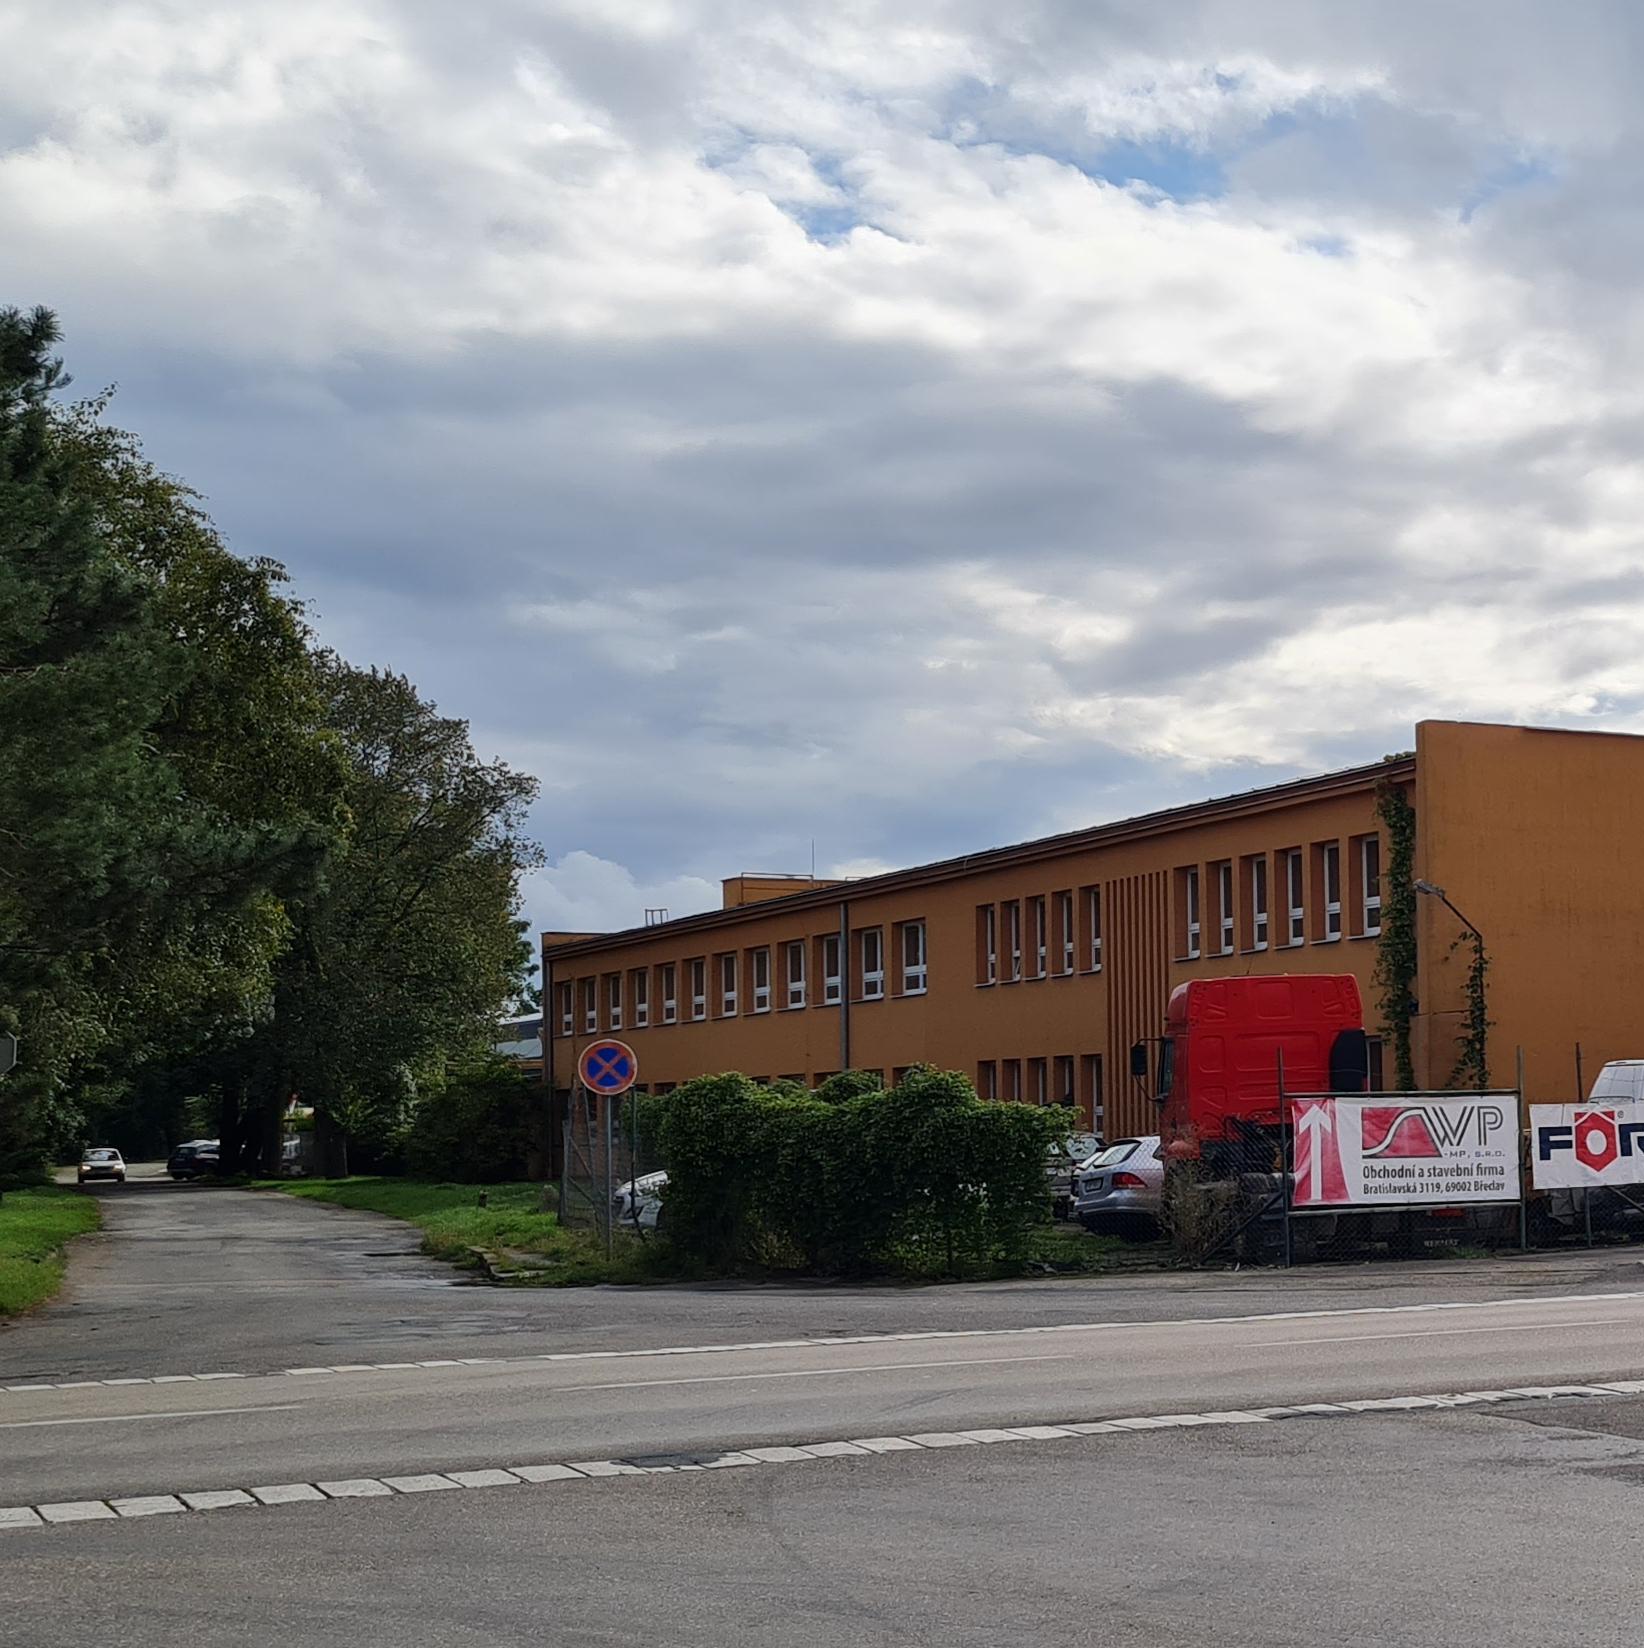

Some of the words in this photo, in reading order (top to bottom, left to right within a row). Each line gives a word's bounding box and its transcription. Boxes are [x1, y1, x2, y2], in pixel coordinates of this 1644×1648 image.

[1362, 1163, 1416, 1179] Obchodní
[1418, 1167, 1425, 1177] a
[1427, 1163, 1474, 1177] stavební
[1476, 1162, 1505, 1176] firma
[1363, 1182, 1417, 1195] Bratislavská
[1419, 1182, 1444, 1194] 3119,
[1445, 1181, 1472, 1193] 69002
[1473, 1179, 1505, 1192] Břeclav
